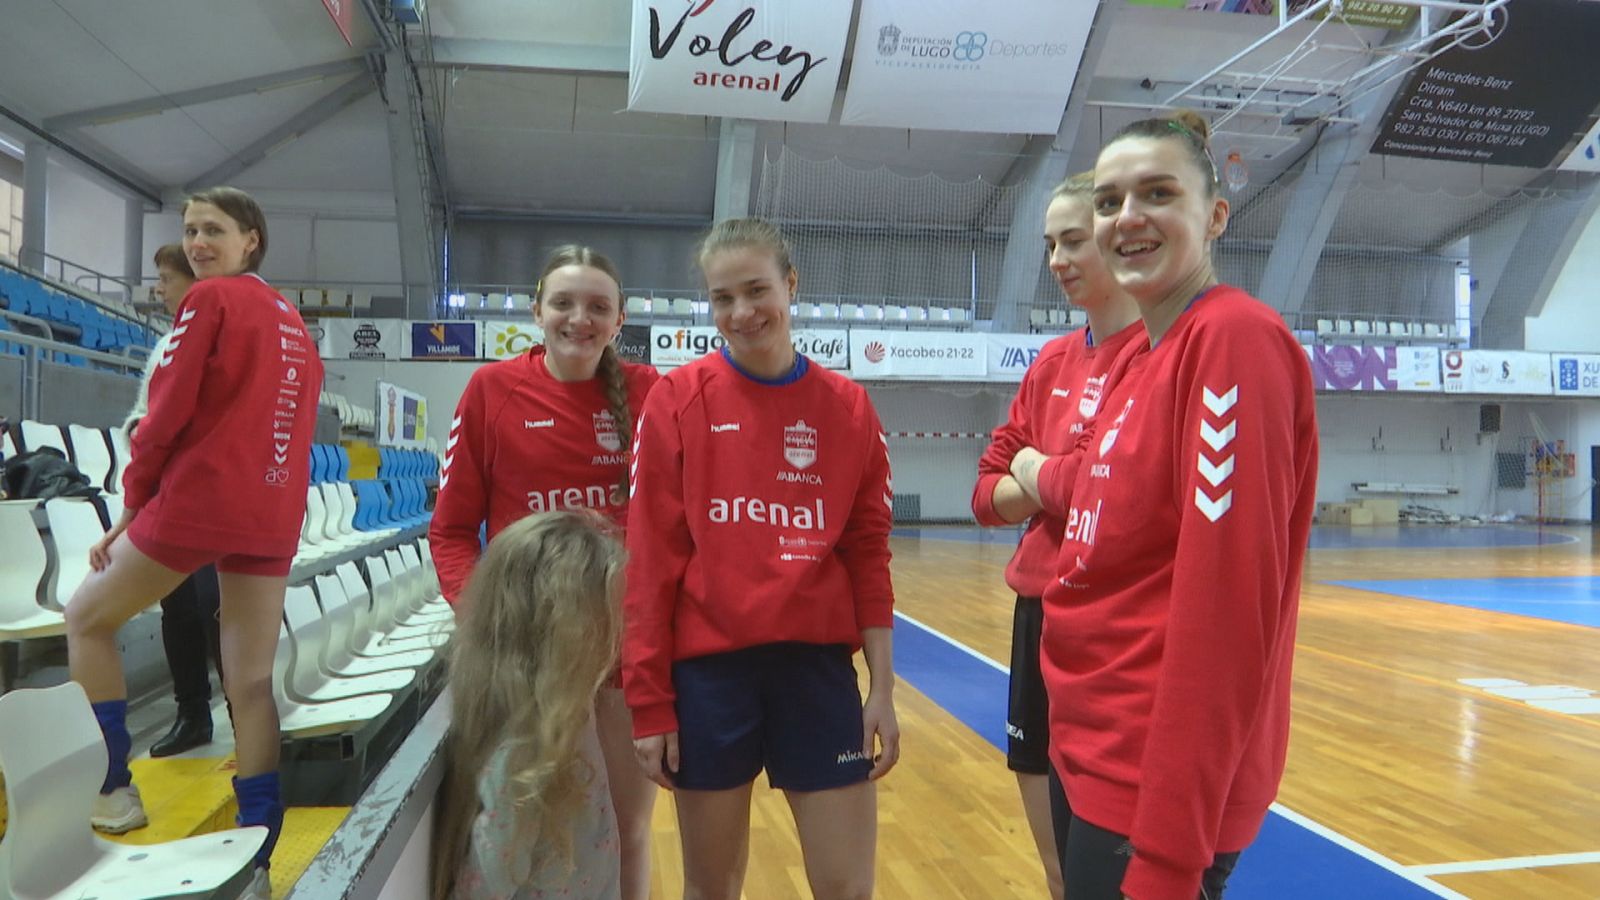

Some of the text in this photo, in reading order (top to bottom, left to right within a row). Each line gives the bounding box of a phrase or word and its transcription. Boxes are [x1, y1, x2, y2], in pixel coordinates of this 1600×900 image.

[649, 1, 827, 101] Voley
[902, 36, 952, 46] DEPUTACIÓN
[911, 45, 950, 59] LUGO
[989, 39, 1068, 59] Deportes
[693, 70, 781, 92] arenal
[1417, 81, 1455, 97] Ditram
[1426, 66, 1514, 91] Mercedes-Benz
[1409, 95, 1433, 109] Crta.
[1436, 100, 1467, 115] N640
[1468, 103, 1485, 115] km
[1394, 122, 1412, 135] 982
[1414, 126, 1436, 137] 263
[1437, 128, 1459, 140] 030
[1465, 132, 1486, 144] 670
[1401, 109, 1421, 121] San
[1423, 111, 1467, 128] Salvador
[1469, 118, 1484, 130] de
[1512, 125, 1551, 136] (LUGO)
[812, 337, 843, 359] Café
[890, 346, 944, 359] Xacobeo
[708, 496, 825, 531] arenal
